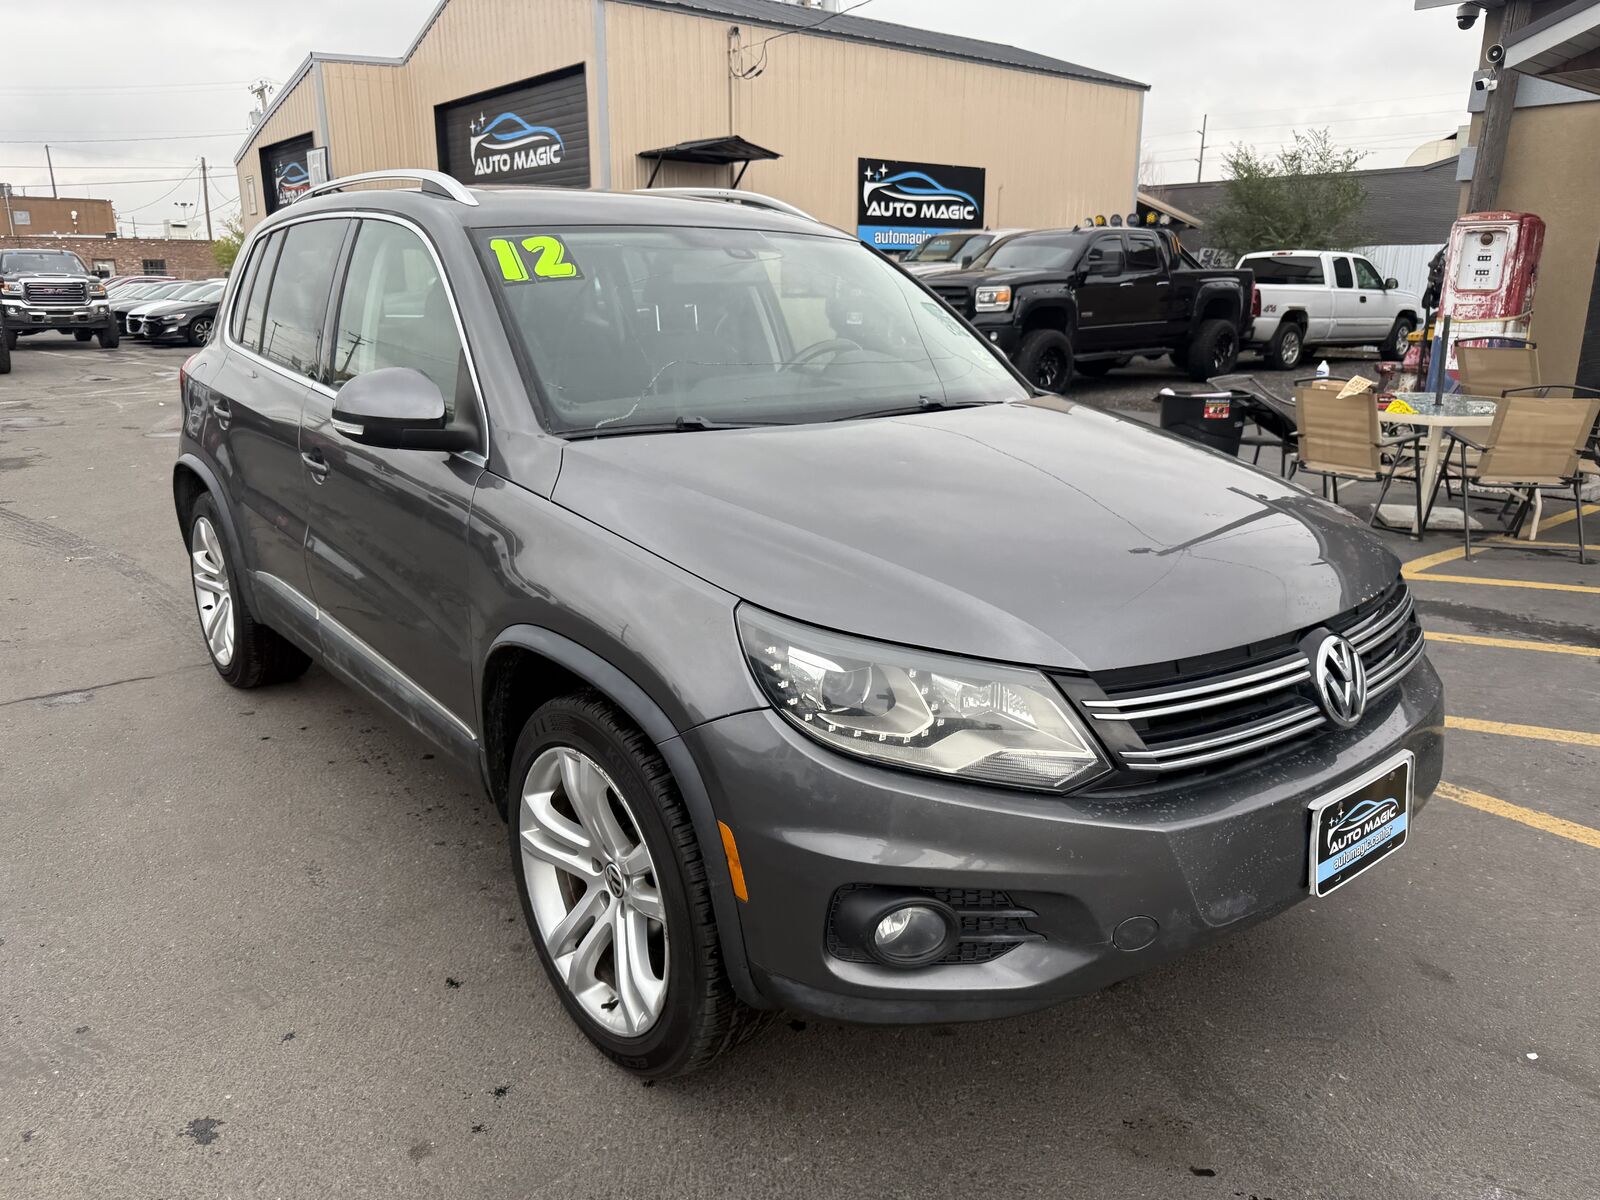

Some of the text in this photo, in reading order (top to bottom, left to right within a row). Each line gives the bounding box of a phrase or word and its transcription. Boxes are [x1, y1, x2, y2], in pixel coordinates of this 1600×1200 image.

[474, 144, 561, 176] AUTO MAGIC
[866, 200, 975, 220] AUTO MAGIC
[490, 236, 577, 281] 12
[1329, 804, 1398, 856] AUTO MAGIC
